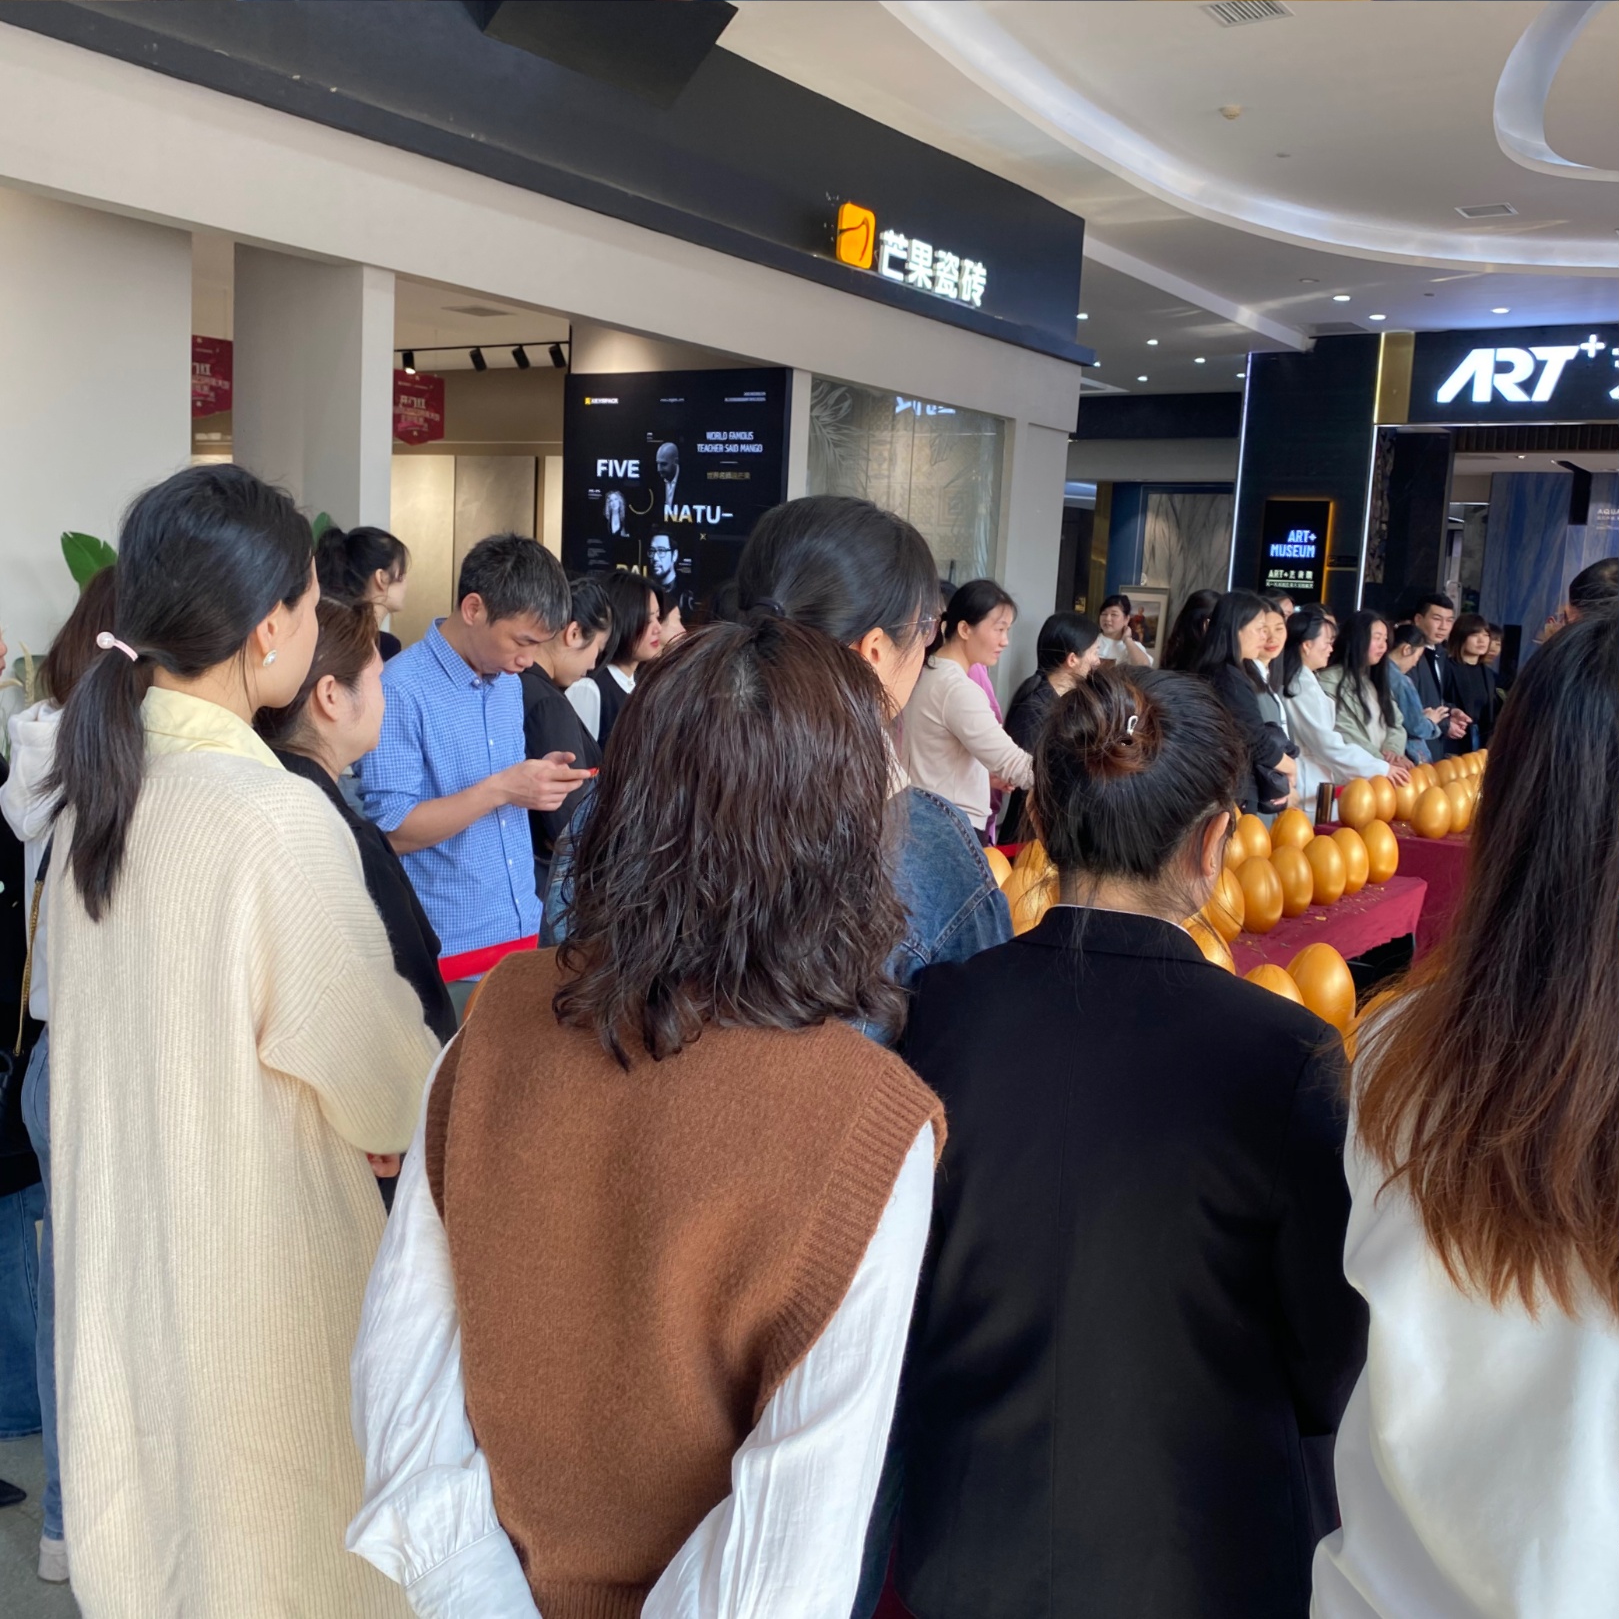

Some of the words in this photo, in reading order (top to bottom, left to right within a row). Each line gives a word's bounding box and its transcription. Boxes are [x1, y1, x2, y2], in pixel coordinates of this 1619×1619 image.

[880, 229, 988, 307] 芒果瓷砖
[706, 431, 728, 441] WORLD
[729, 431, 754, 441] FAMOUS
[697, 443, 724, 453] TEACHER
[739, 443, 763, 453] MANGO
[596, 458, 641, 479] FIVE
[1270, 543, 1316, 558] MUSEUM
